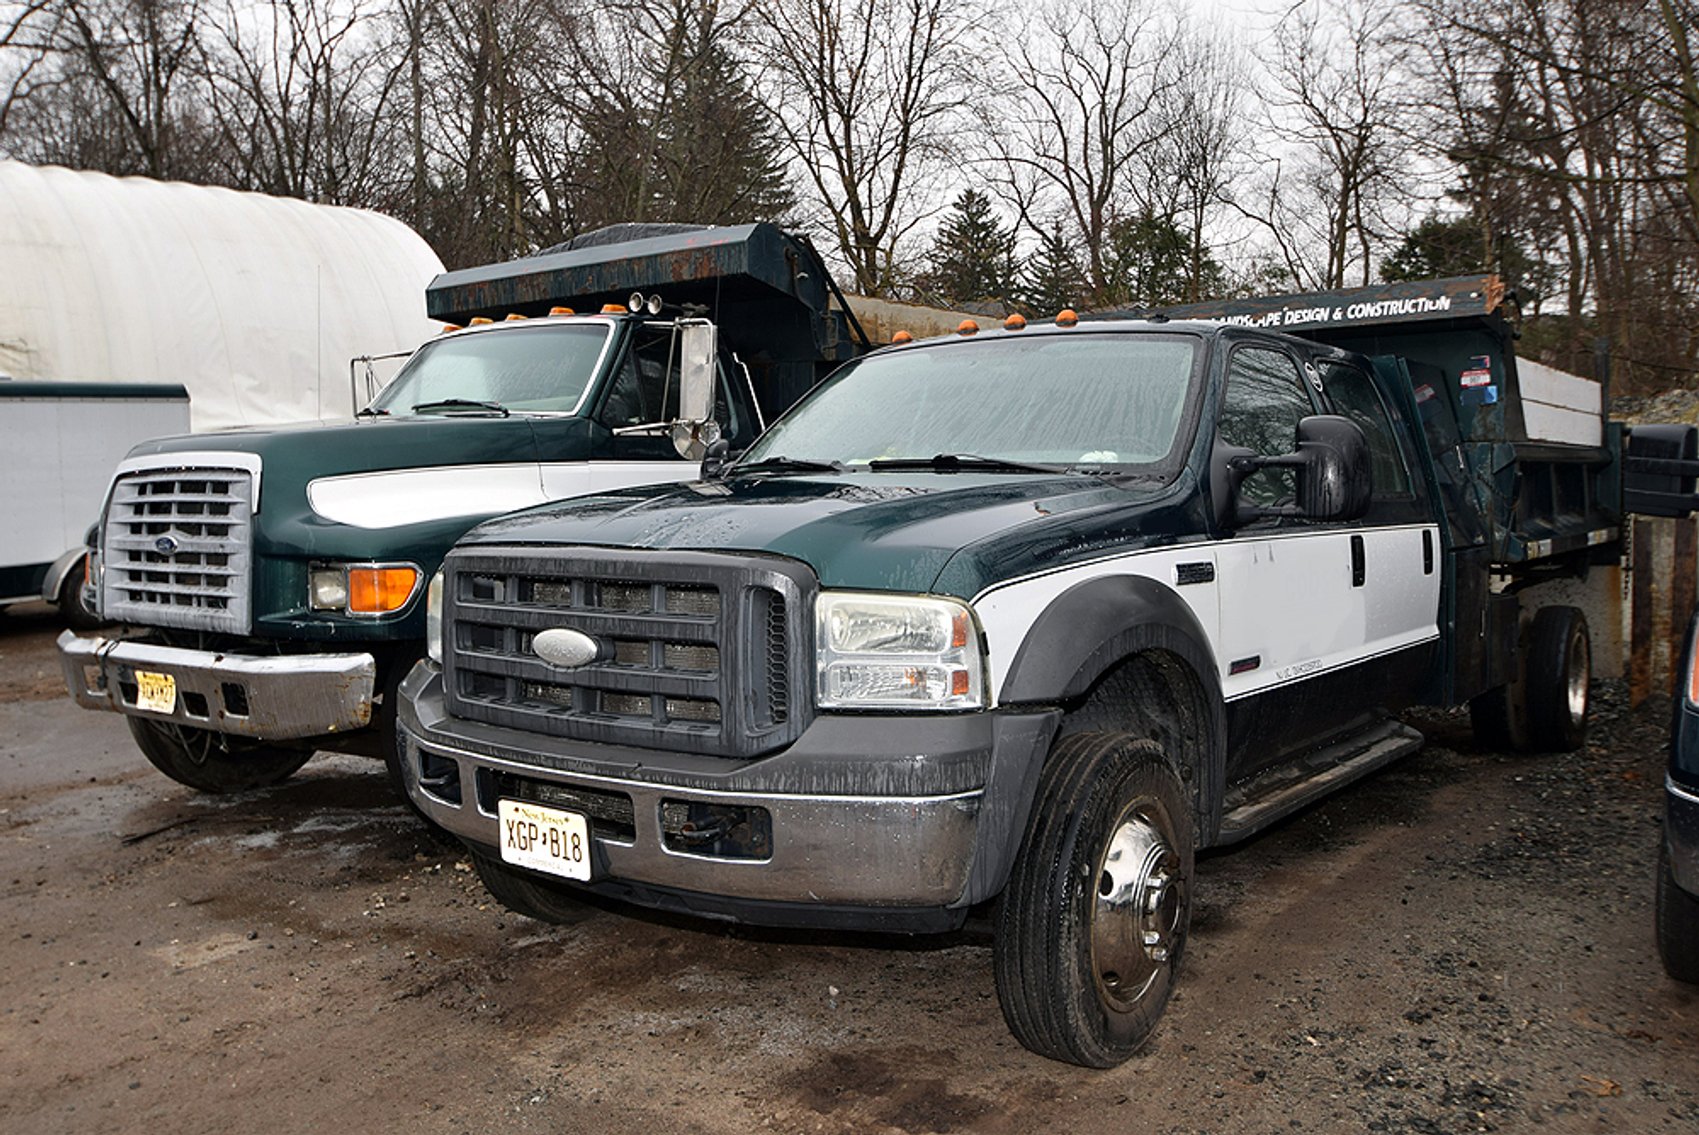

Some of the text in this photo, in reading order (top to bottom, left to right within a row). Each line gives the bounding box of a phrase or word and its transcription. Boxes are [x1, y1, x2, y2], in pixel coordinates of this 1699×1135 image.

[1284, 307, 1330, 325] DESIGN
[1332, 307, 1342, 320] &
[1347, 296, 1451, 319] CONSTRUCTION
